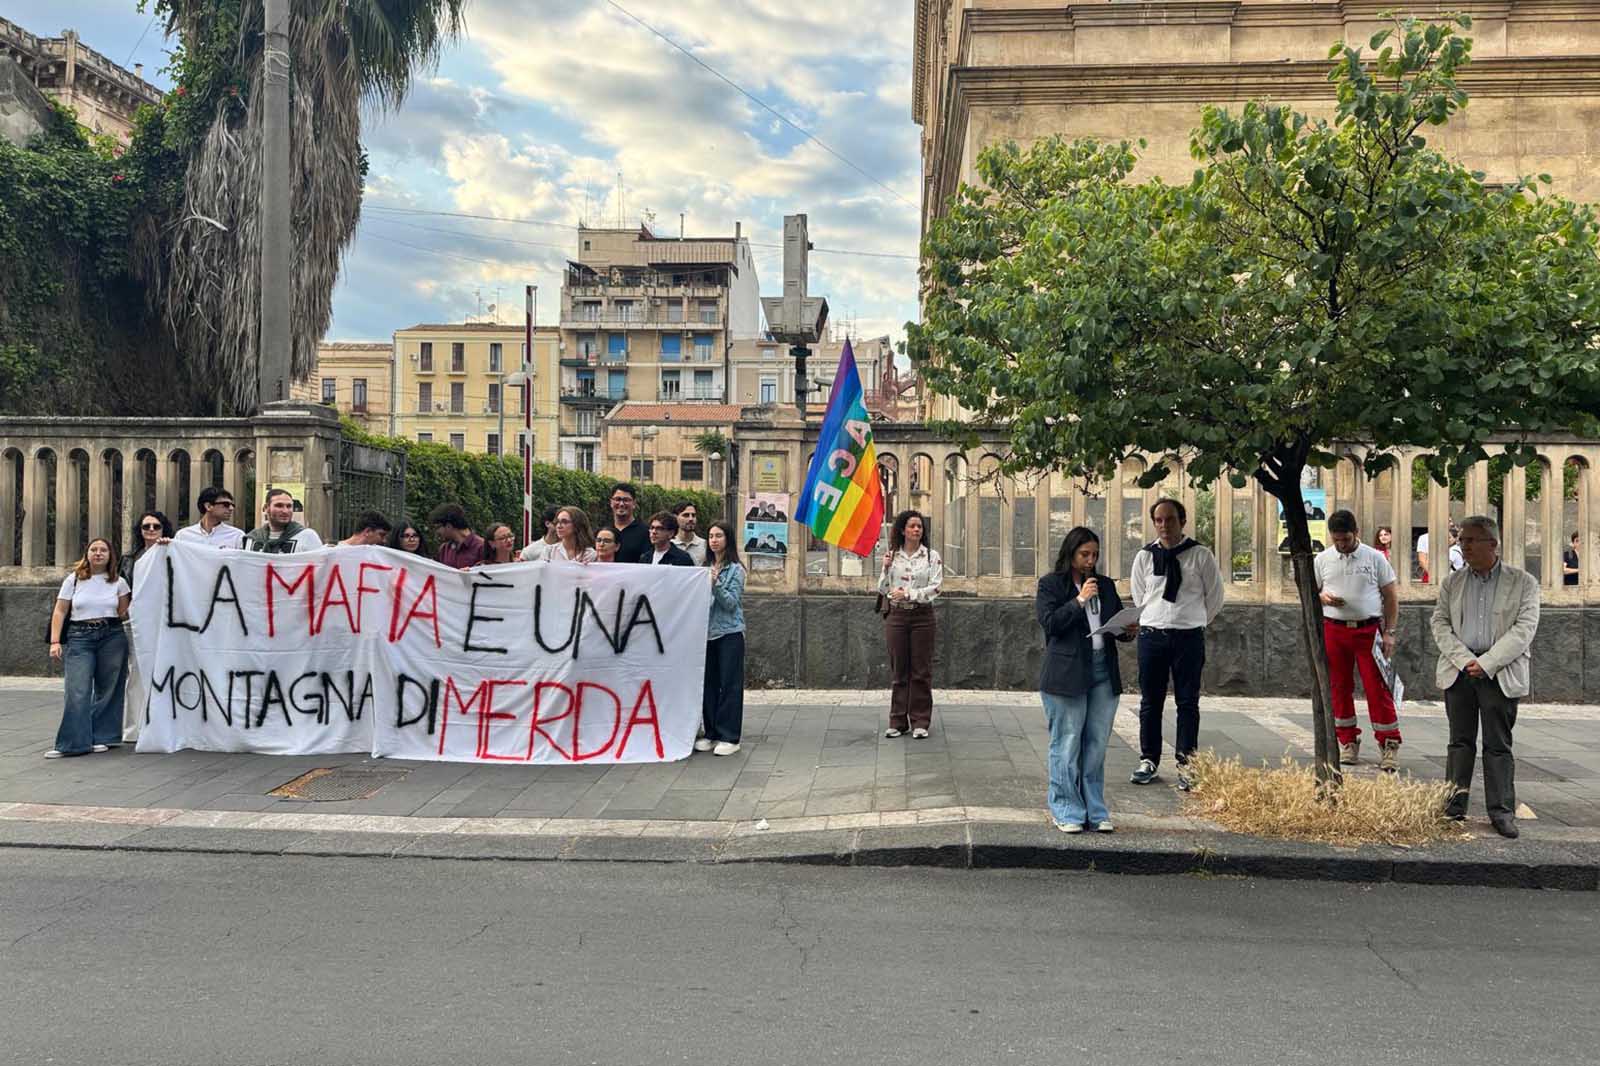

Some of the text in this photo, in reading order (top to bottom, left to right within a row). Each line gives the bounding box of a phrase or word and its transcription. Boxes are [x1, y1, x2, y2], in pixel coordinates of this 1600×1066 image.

[166, 555, 665, 660] LA MAFIA È UNA
[145, 664, 375, 730] MONTAGNA
[438, 675, 665, 763] MERDA
